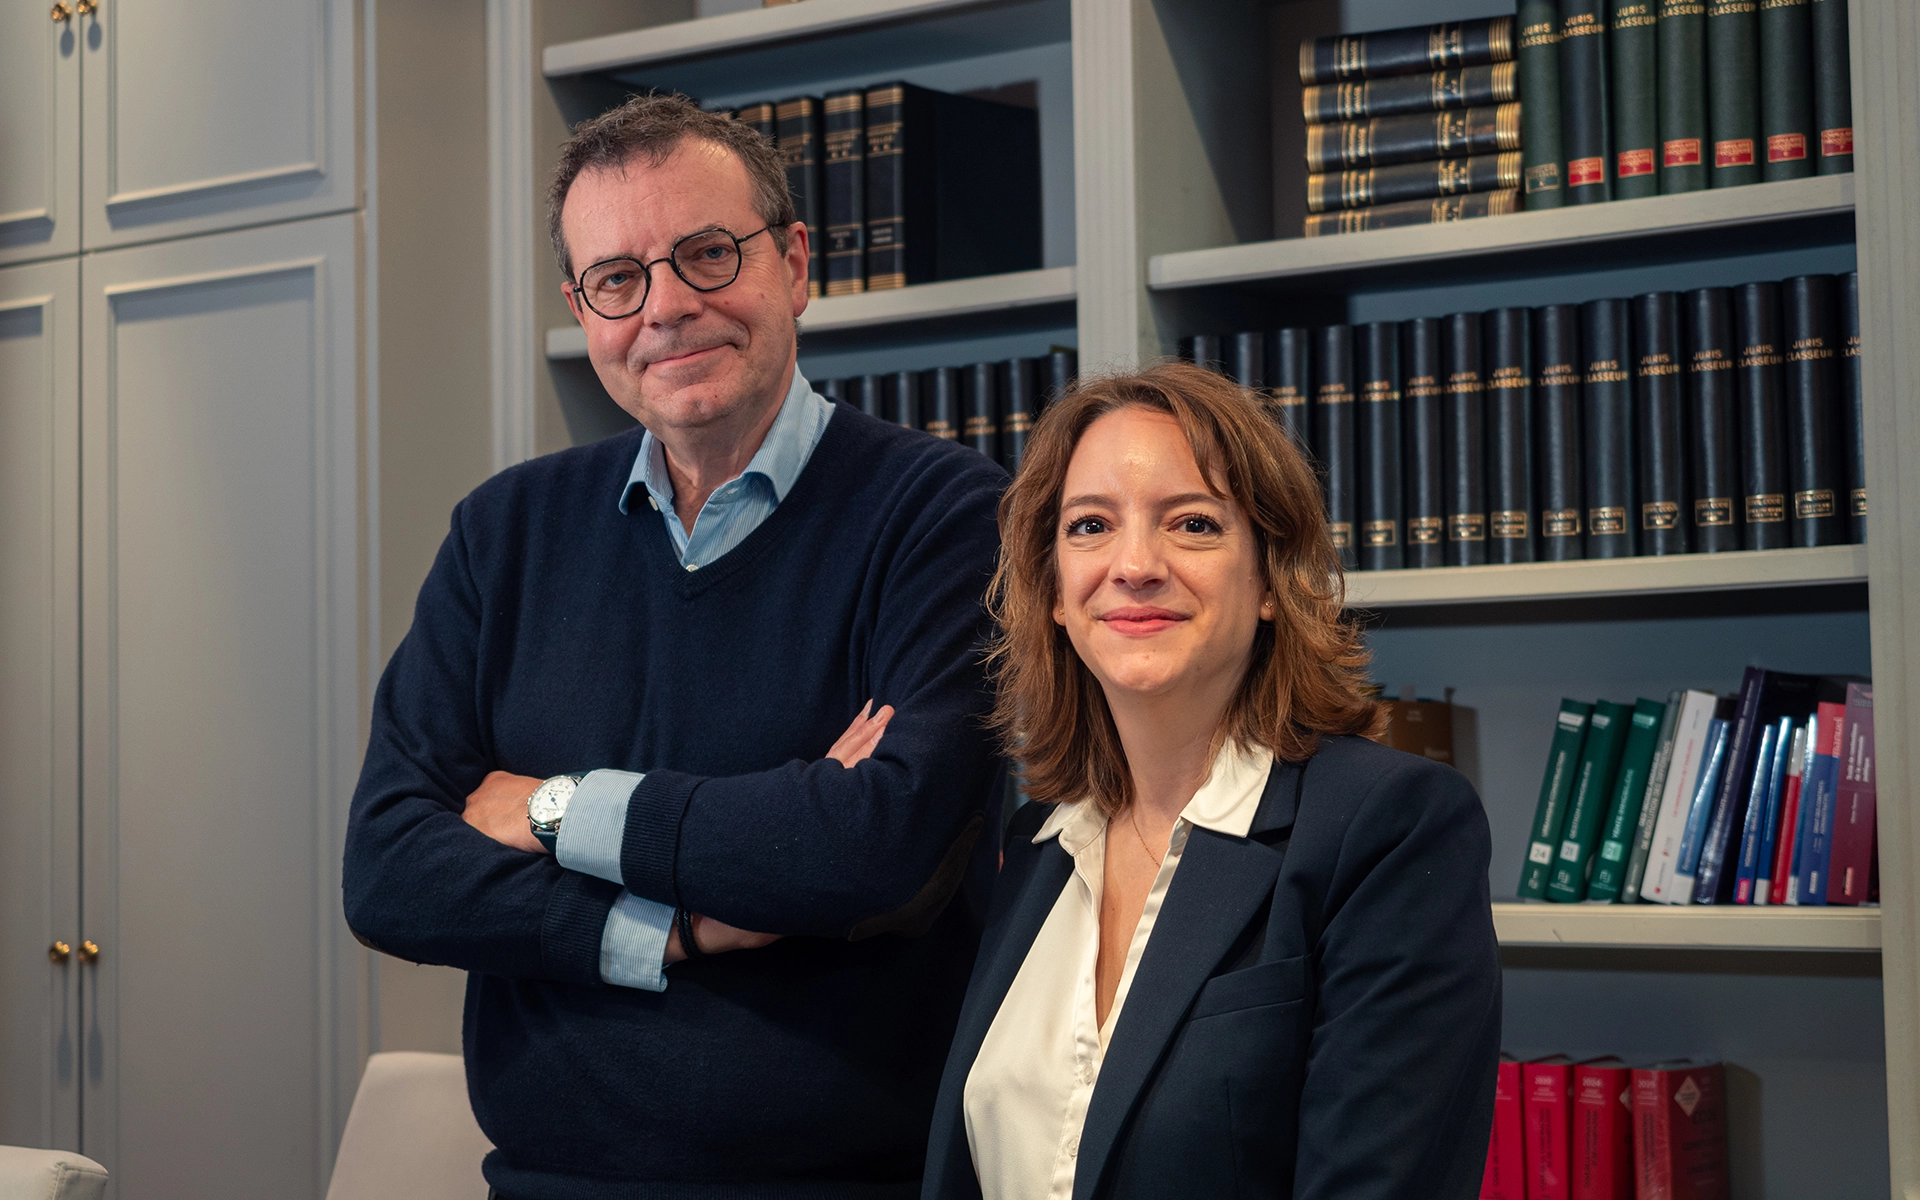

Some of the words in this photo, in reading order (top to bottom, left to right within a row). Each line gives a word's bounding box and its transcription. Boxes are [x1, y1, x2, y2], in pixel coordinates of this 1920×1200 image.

[1617, 5, 1646, 17] JURIS
[1707, 4, 1756, 17] CLASSEUR
[1760, 0, 1807, 10] CLASSE
[1658, 5, 1704, 18] CLASSEUR
[1565, 13, 1595, 27] JURIS
[1522, 22, 1551, 36] JURIS
[1560, 24, 1604, 38] CLASSEUR
[1793, 337, 1823, 349] JURIS
[1693, 349, 1722, 361] JURIS
[1743, 344, 1773, 356] JURIS
[1786, 349, 1833, 362] CLASSEUR
[1641, 353, 1669, 365] JURIS
[1543, 364, 1572, 375] JURIS
[1589, 360, 1618, 371] JURIS
[1449, 372, 1478, 382] JURIS
[1493, 367, 1521, 378] JURIS
[1408, 376, 1435, 386] JURIS
[1405, 386, 1442, 397] LASSEUR
[1829, 716, 1843, 758] manuel
[1738, 881, 1748, 900] 2020
[1582, 1077, 1602, 1088] 2024
